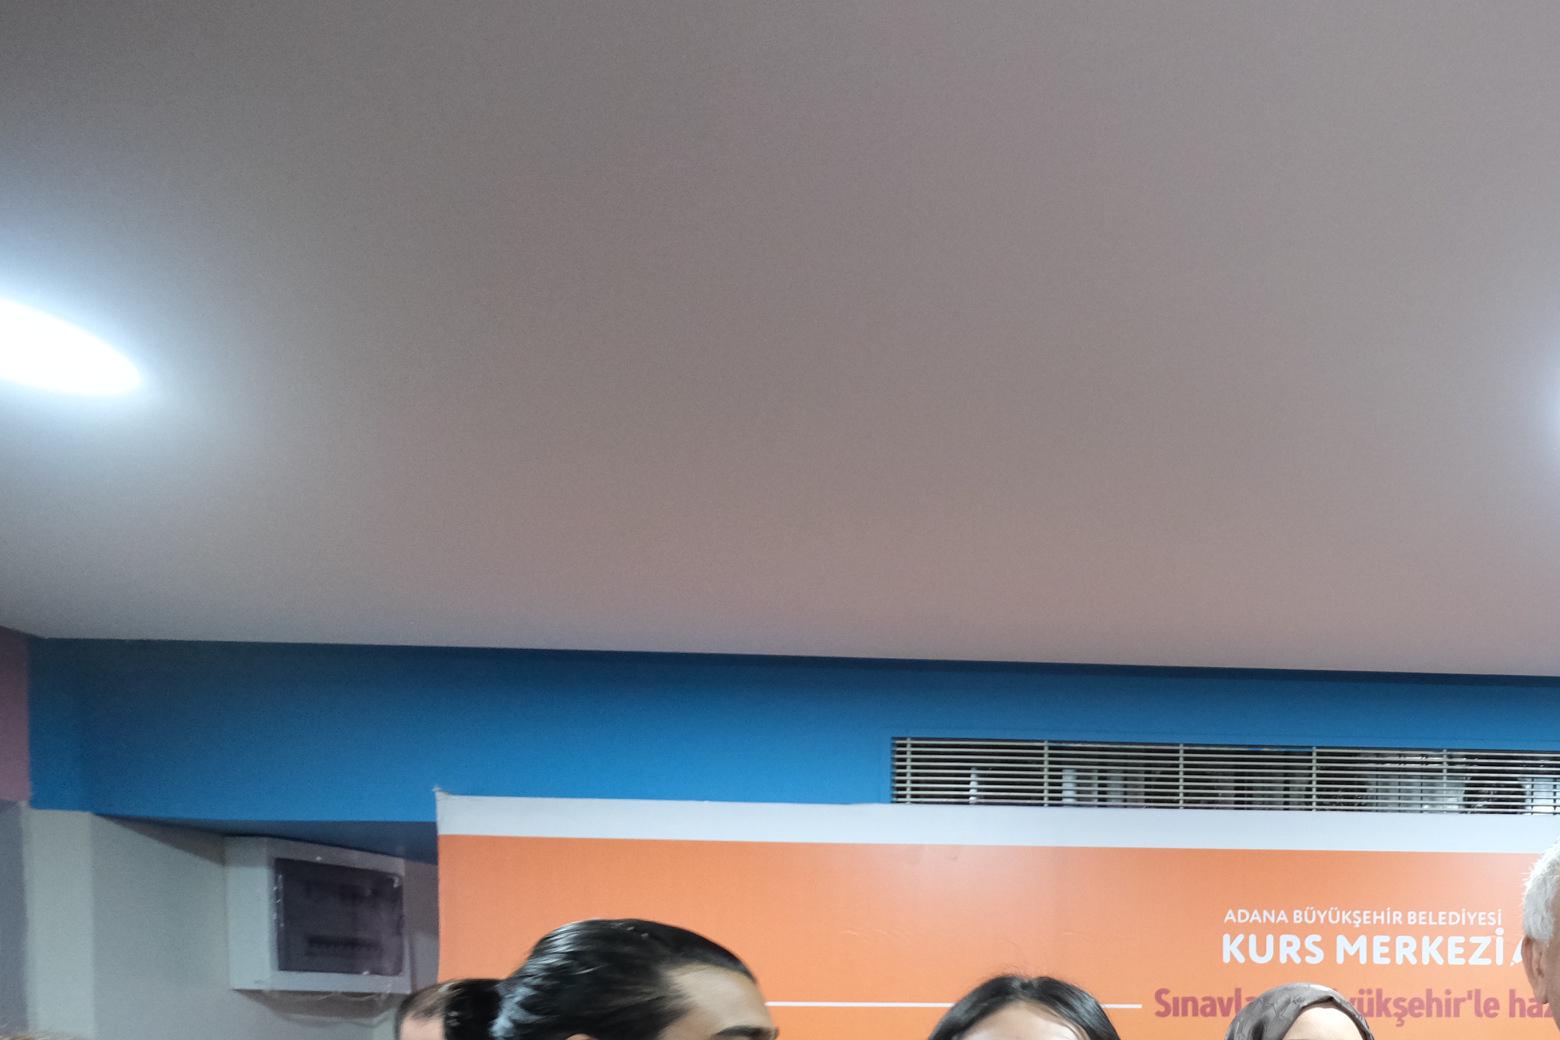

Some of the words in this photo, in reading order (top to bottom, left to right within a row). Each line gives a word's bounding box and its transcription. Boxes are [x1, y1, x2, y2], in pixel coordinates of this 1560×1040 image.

[1223, 908, 1290, 924] ADANA
[1293, 906, 1403, 928] BÜYÜKŞEHİR
[1407, 908, 1503, 926] BELEDİYESİ
[1222, 933, 1325, 965] KURS
[1336, 927, 1505, 966] MERKEZİ
[1154, 987, 1256, 1018] Sınavl
[1349, 988, 1500, 1028] ükşehir'le
